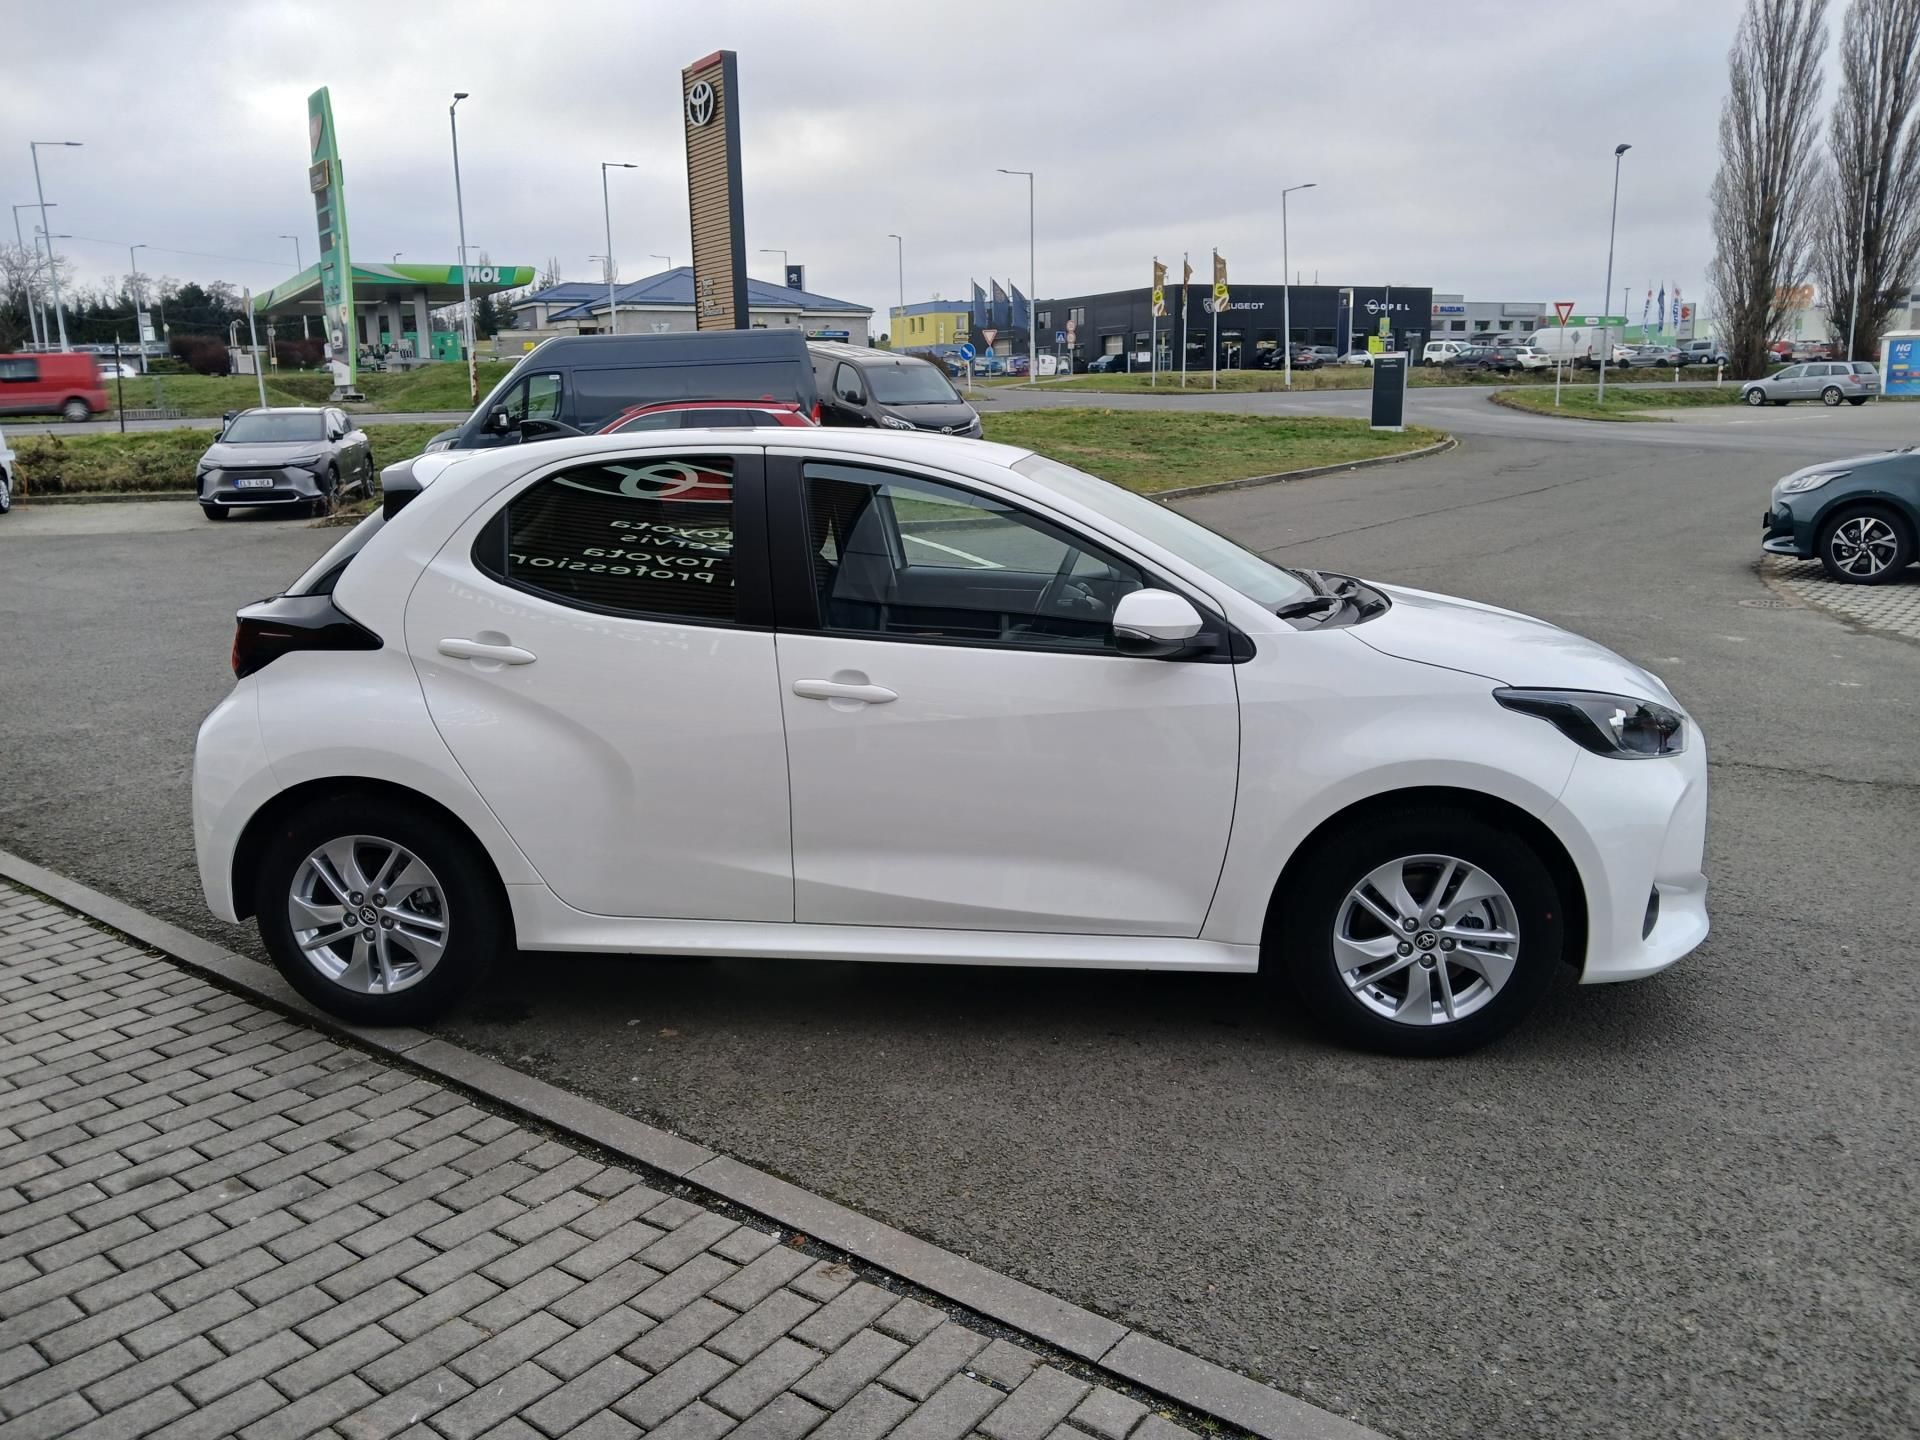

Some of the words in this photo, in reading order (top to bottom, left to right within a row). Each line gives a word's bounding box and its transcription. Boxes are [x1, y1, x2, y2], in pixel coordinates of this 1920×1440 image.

[466, 266, 501, 283] MOL
[1228, 302, 1265, 310] UGEOT
[1380, 303, 1410, 311] OPEL
[1895, 343, 1912, 352] HG
